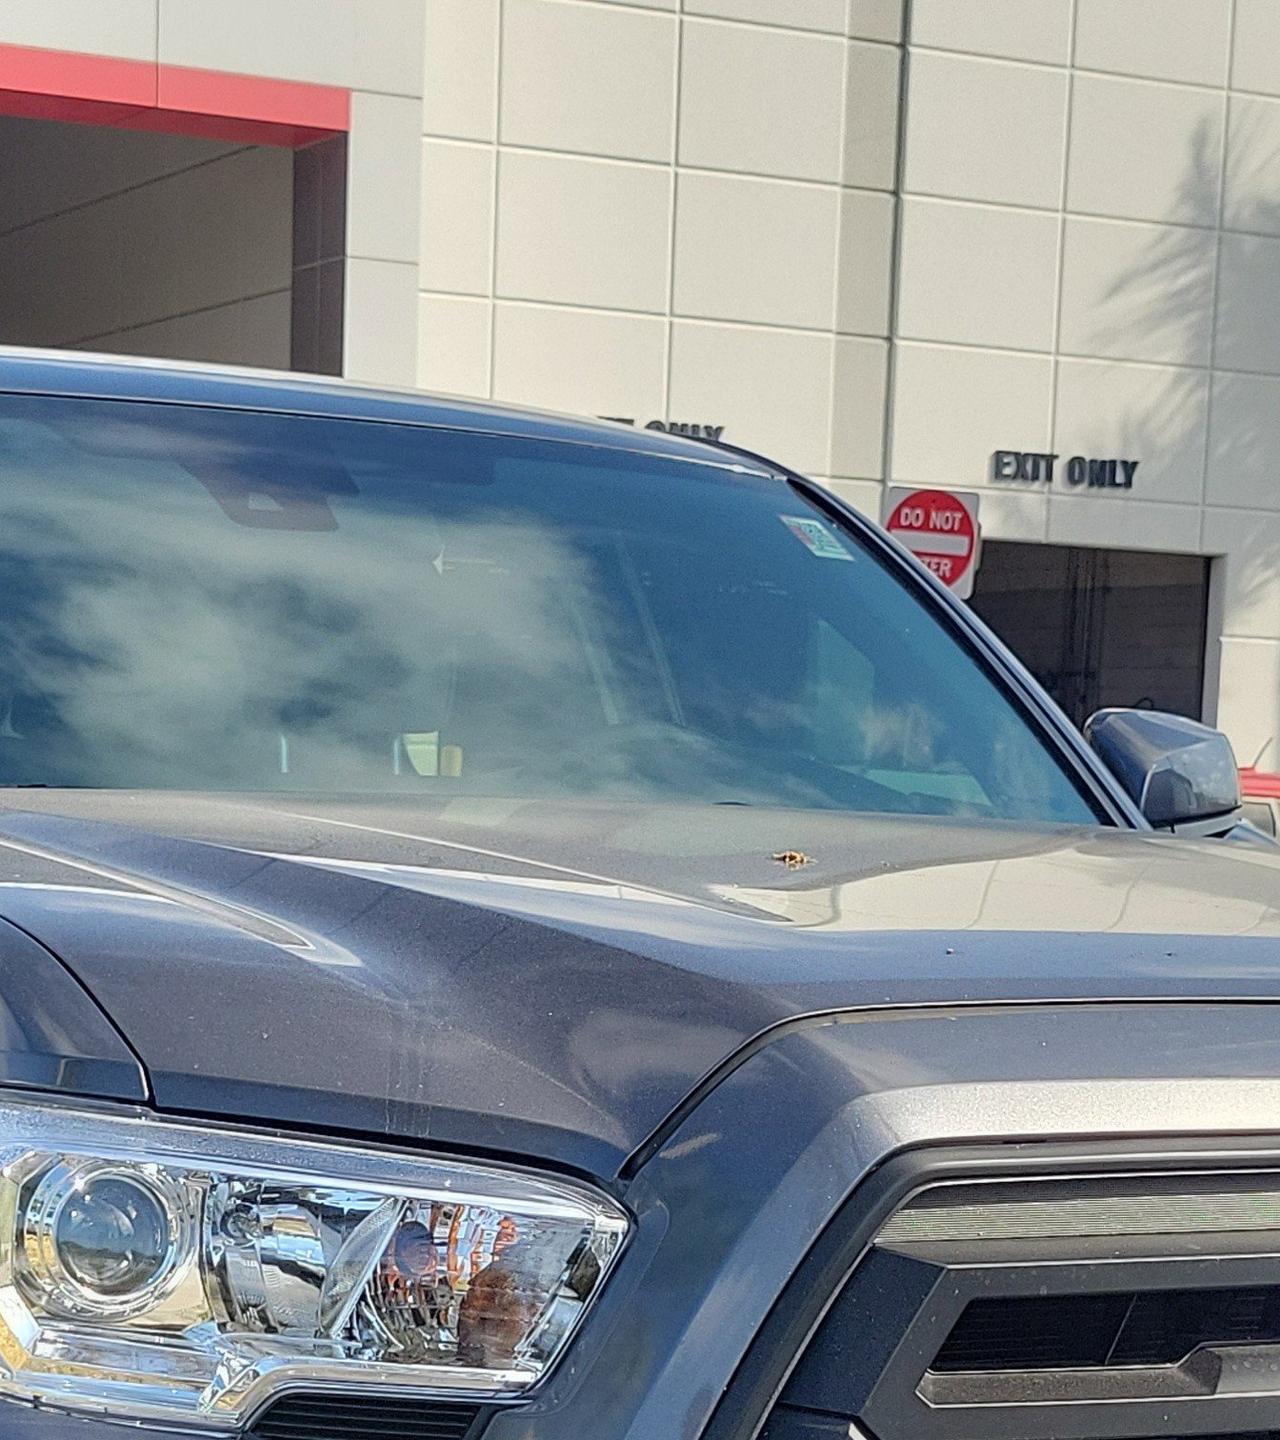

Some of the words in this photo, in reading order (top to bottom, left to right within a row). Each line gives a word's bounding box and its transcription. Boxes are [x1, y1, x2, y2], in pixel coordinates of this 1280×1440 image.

[993, 450, 1060, 483] EXIT
[1066, 456, 1140, 489] ONLY
[900, 507, 924, 527] DO
[929, 511, 963, 531] NOT
[920, 557, 952, 577] TER
